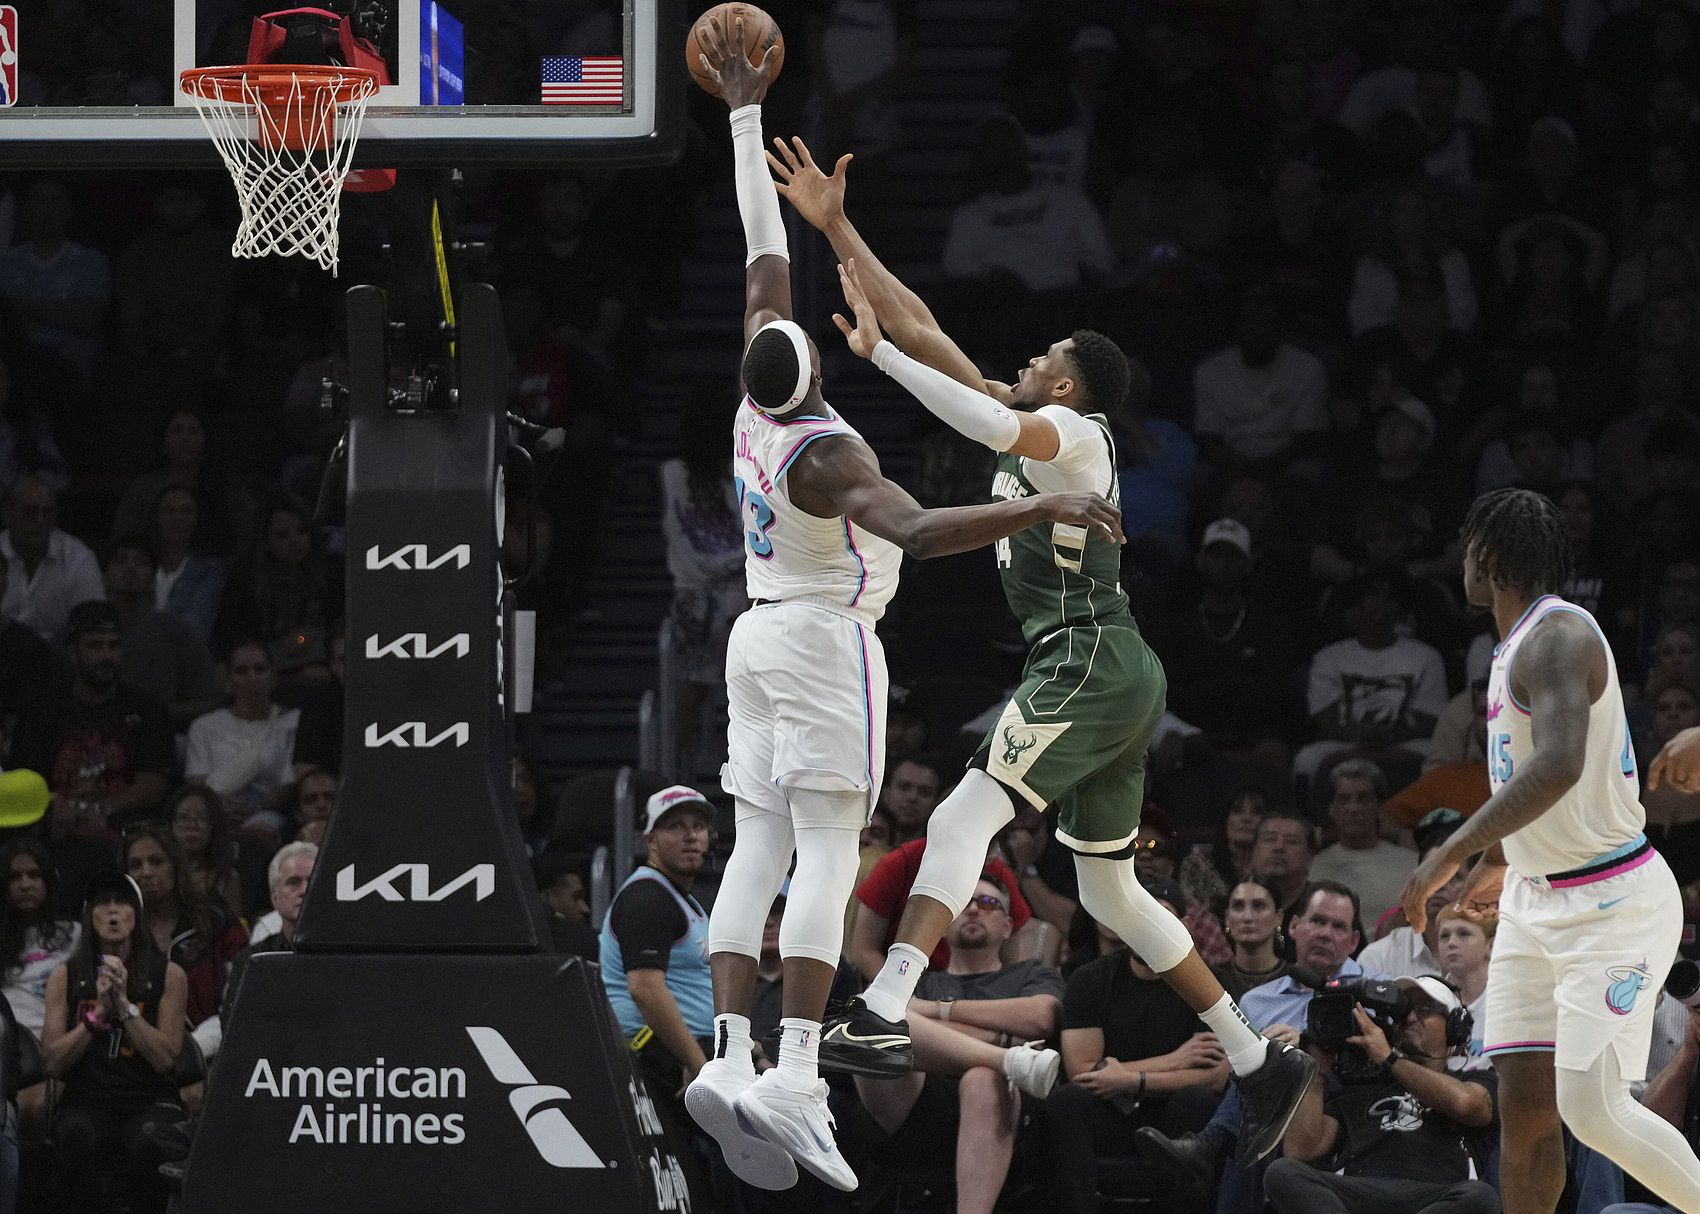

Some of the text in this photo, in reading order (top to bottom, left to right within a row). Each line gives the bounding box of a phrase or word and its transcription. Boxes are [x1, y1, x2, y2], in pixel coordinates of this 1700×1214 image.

[366, 544, 471, 570] KIA
[365, 633, 470, 658] KIA
[365, 721, 470, 747] KIA
[336, 863, 495, 902] KIA
[244, 1057, 466, 1099] American
[288, 1103, 466, 1145] Airlines
